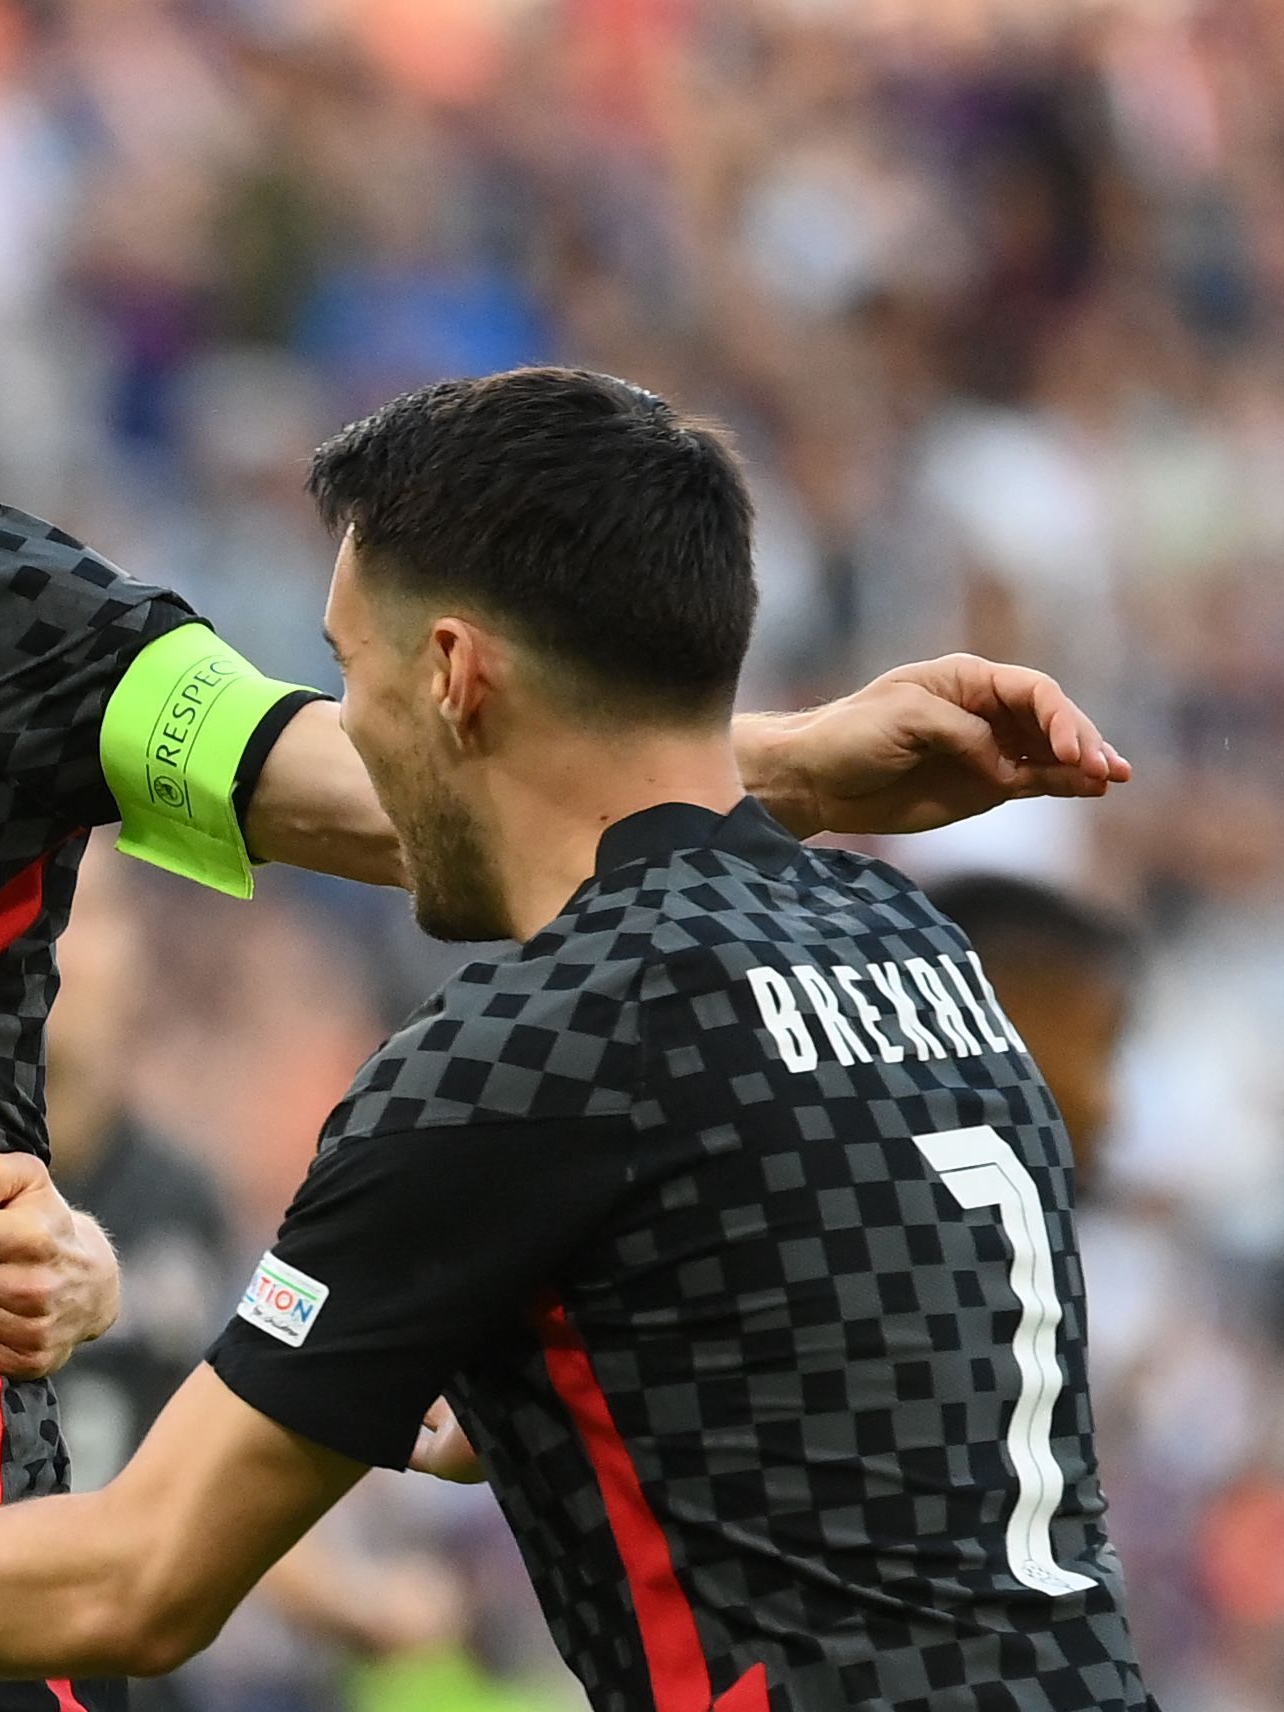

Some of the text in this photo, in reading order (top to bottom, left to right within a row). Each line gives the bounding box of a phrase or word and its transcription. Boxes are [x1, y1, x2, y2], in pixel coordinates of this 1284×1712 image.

[155, 660, 237, 768] RESPEC
[254, 1276, 314, 1323] TION
[912, 1125, 1099, 1597] 7
